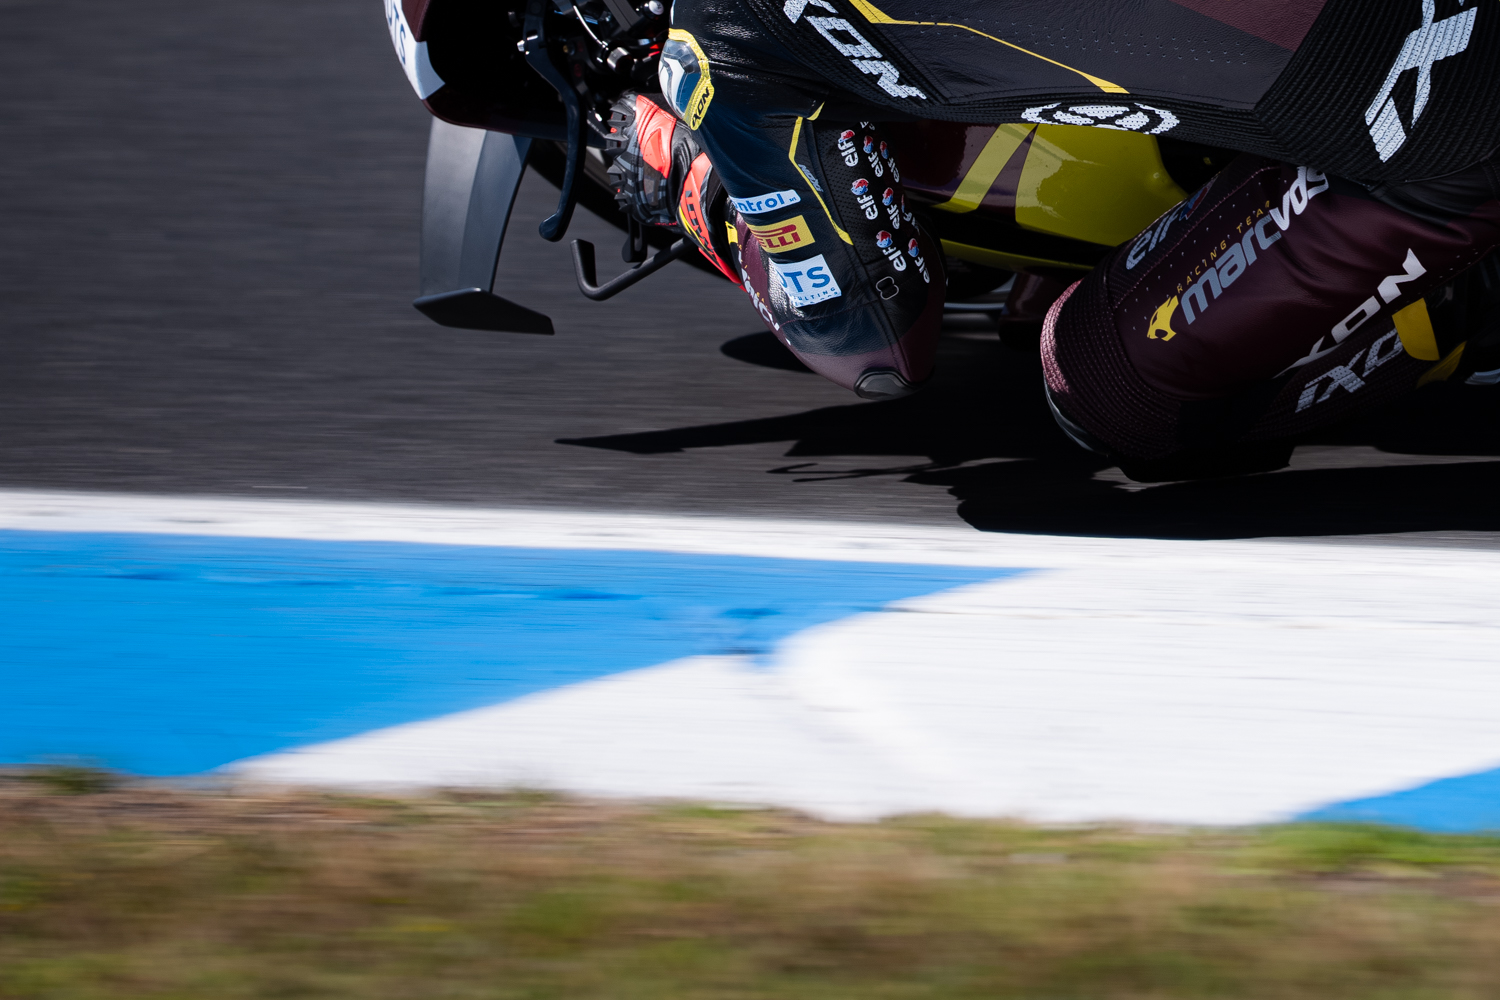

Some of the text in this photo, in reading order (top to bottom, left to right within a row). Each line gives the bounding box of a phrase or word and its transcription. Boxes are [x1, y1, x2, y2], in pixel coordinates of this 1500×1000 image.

[838, 140, 859, 167] elf
[868, 151, 884, 178] elf
[887, 157, 900, 183] elf
[734, 193, 785, 212] ntrol
[857, 195, 878, 220] elf
[887, 204, 900, 230] elf
[1126, 202, 1185, 270] elf
[883, 246, 907, 272] elf
[914, 256, 930, 284] elf
[1177, 239, 1227, 293] RACING
[1295, 327, 1404, 414] IXO
